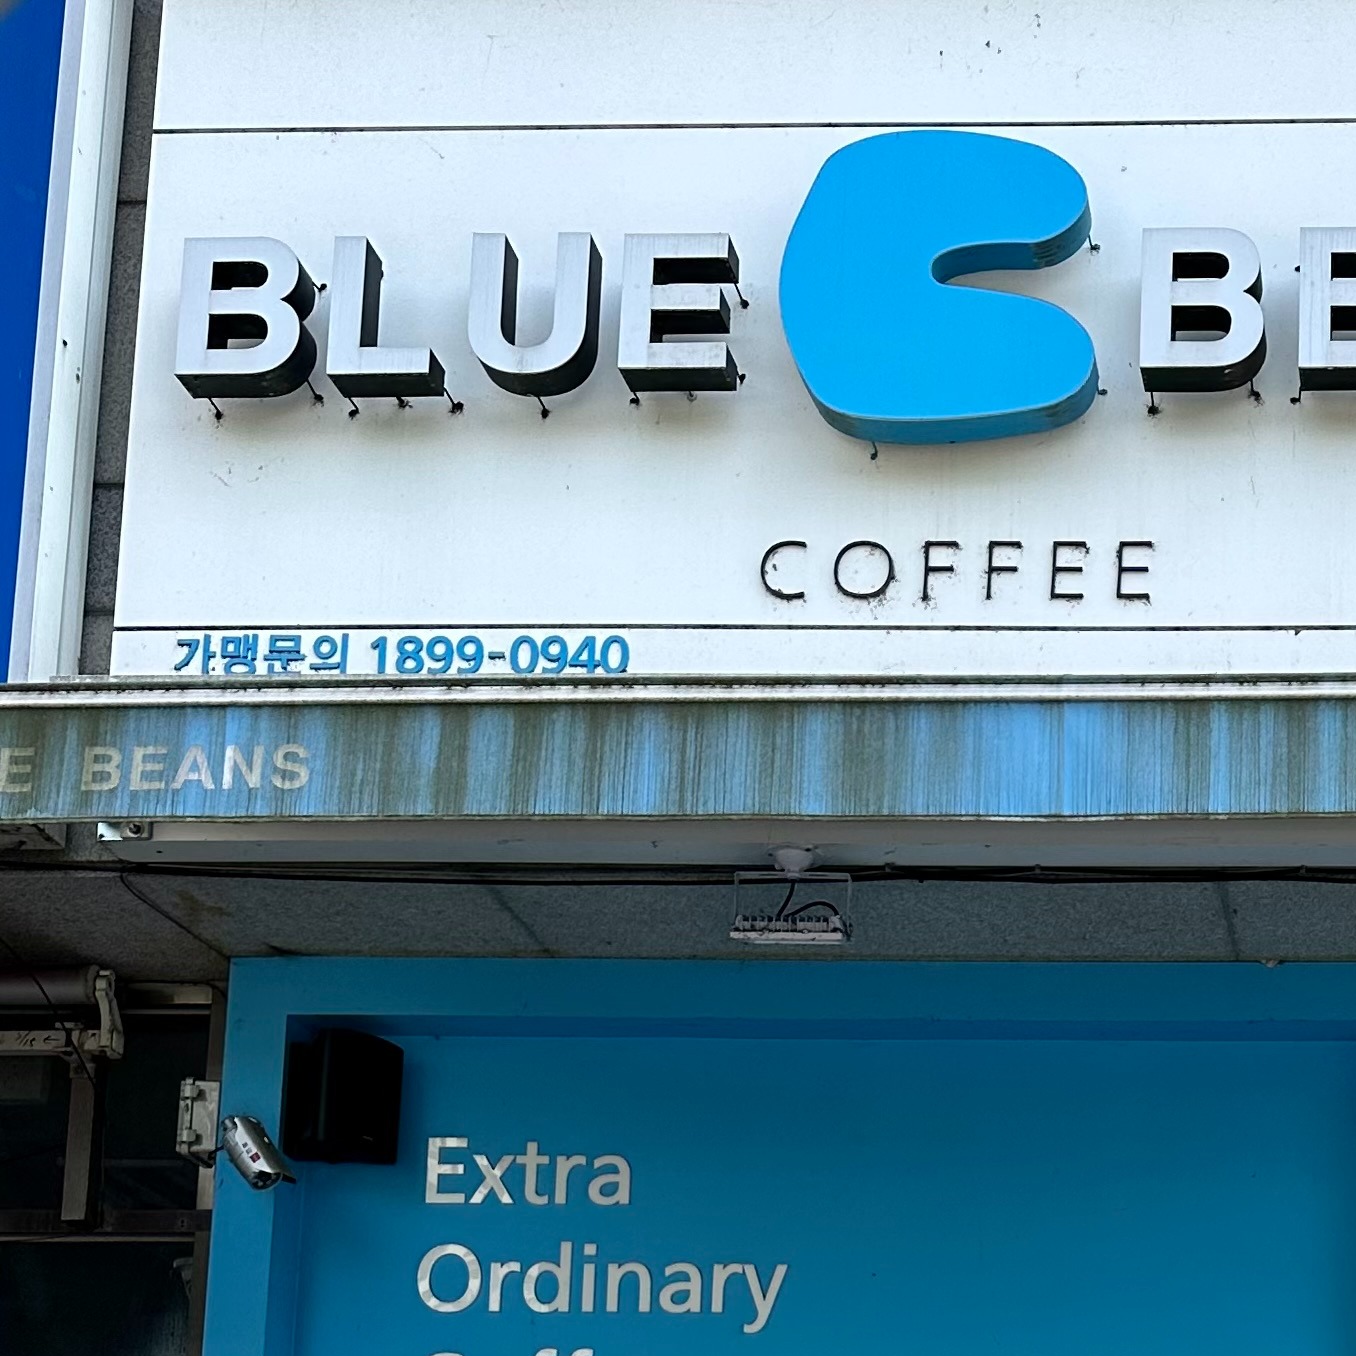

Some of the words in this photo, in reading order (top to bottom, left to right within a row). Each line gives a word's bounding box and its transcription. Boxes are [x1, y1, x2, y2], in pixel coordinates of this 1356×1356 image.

[173, 232, 739, 398] BLUE
[760, 540, 1153, 601] COFFEE
[174, 634, 348, 675] 가맹문의
[370, 635, 631, 675] 1899-0940
[80, 743, 311, 791] BEANS
[424, 1136, 632, 1205] Extra
[417, 1241, 789, 1334] Ordinary
